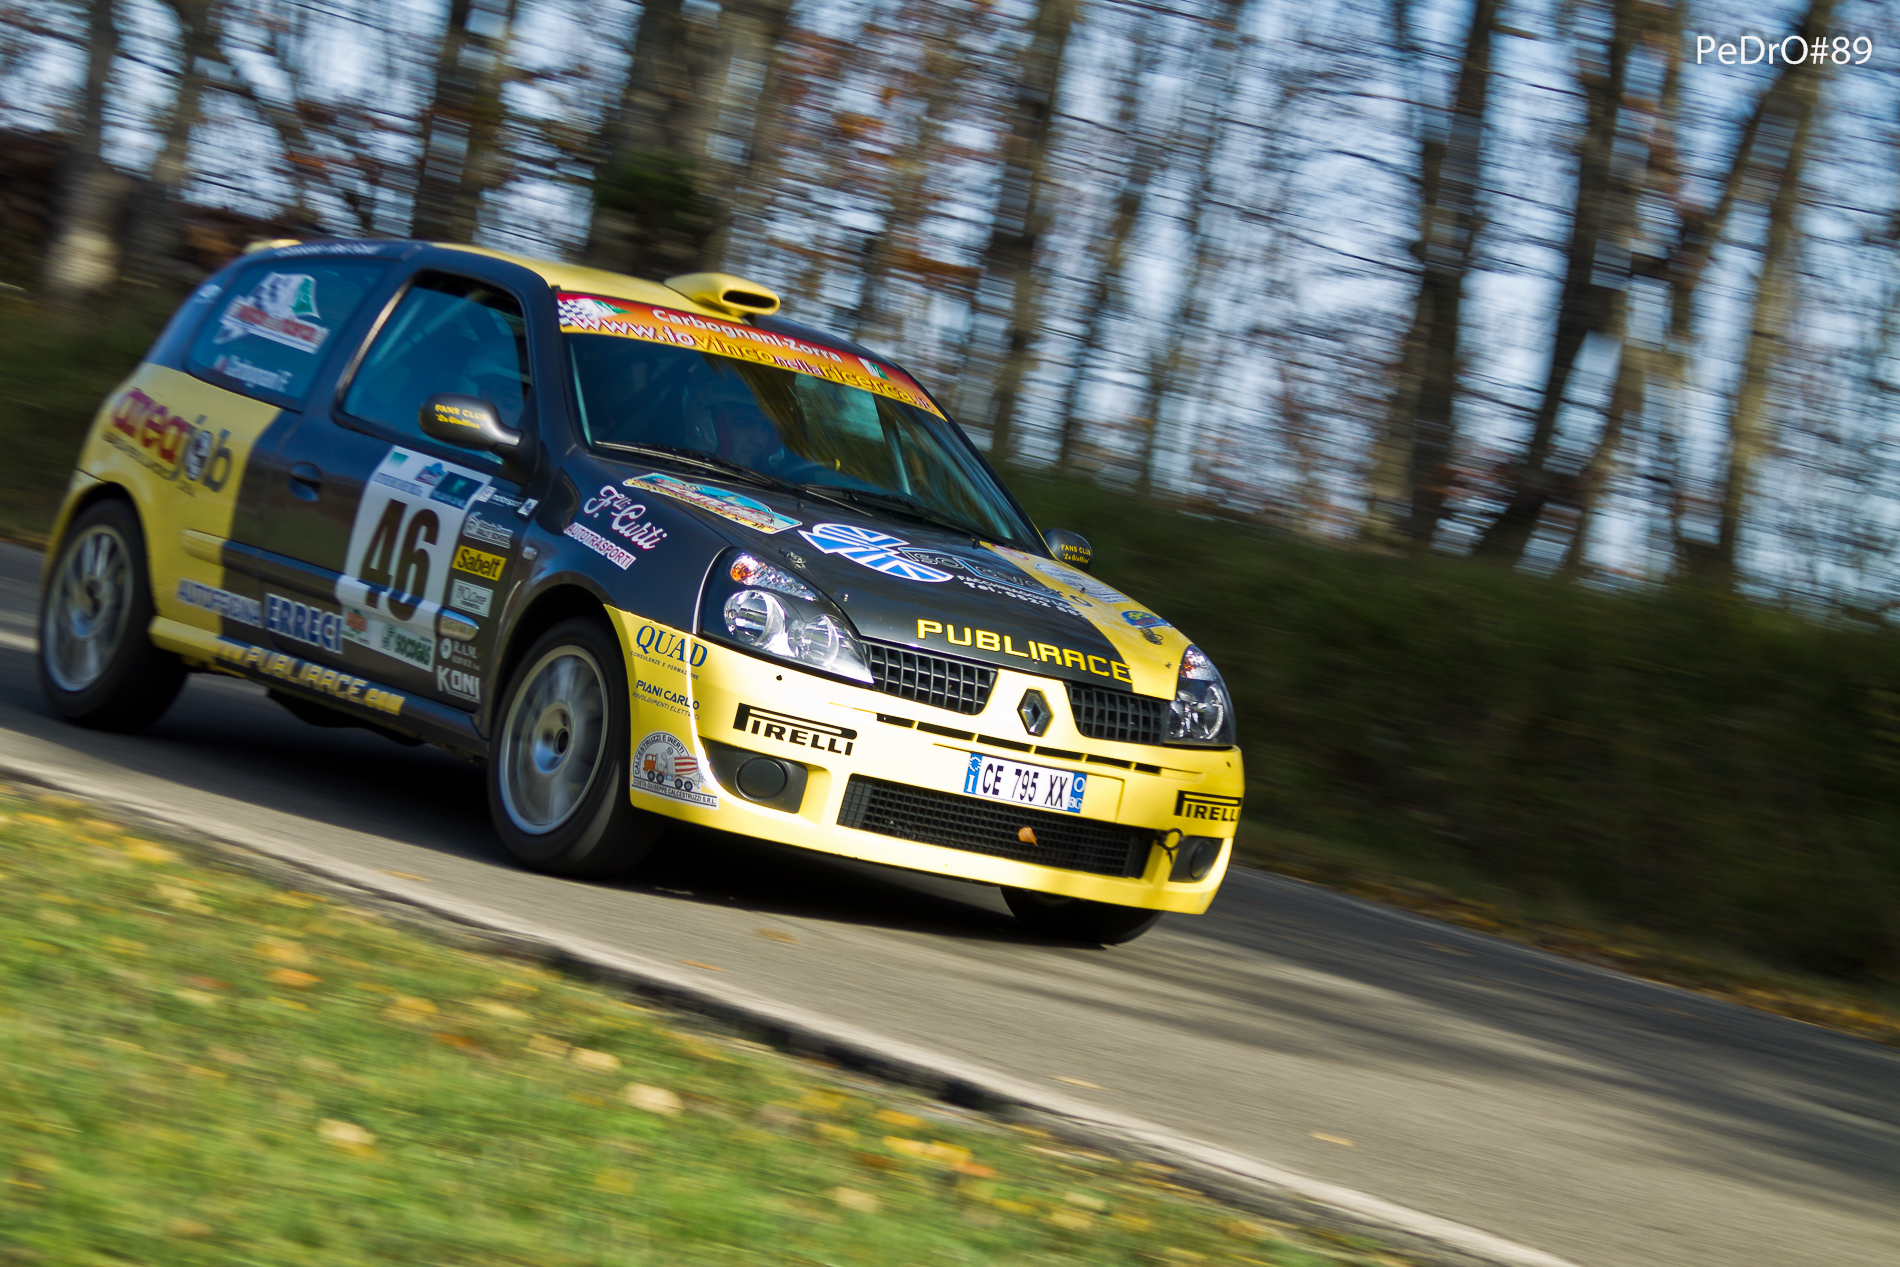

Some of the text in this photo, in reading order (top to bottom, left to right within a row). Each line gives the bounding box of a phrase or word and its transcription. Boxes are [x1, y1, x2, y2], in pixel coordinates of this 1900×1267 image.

[567, 523, 634, 568] AUTOTRASPORTI
[609, 504, 668, 550] Curti
[357, 498, 440, 621] 46
[457, 549, 501, 578] Sabelt
[1060, 543, 1091, 556] FANS CLUB
[630, 650, 661, 666] CONSULENZE
[636, 625, 708, 667] QUAD
[916, 618, 1133, 684] PUBLIRACE
[437, 665, 481, 703] KONI
[632, 691, 670, 710] AVVOLGIMENTI
[636, 679, 700, 710] PIANI CARLO
[732, 702, 858, 756] PIRELLI
[634, 734, 685, 775] CALCESTRUZZI E INERTI
[633, 778, 647, 788] COSTA
[646, 782, 668, 794] GIUSEPPE
[667, 788, 702, 802] CALCESTRUZZI
[982, 763, 1004, 796] CE
[1011, 768, 1040, 802] 795
[1044, 774, 1068, 808] XX
